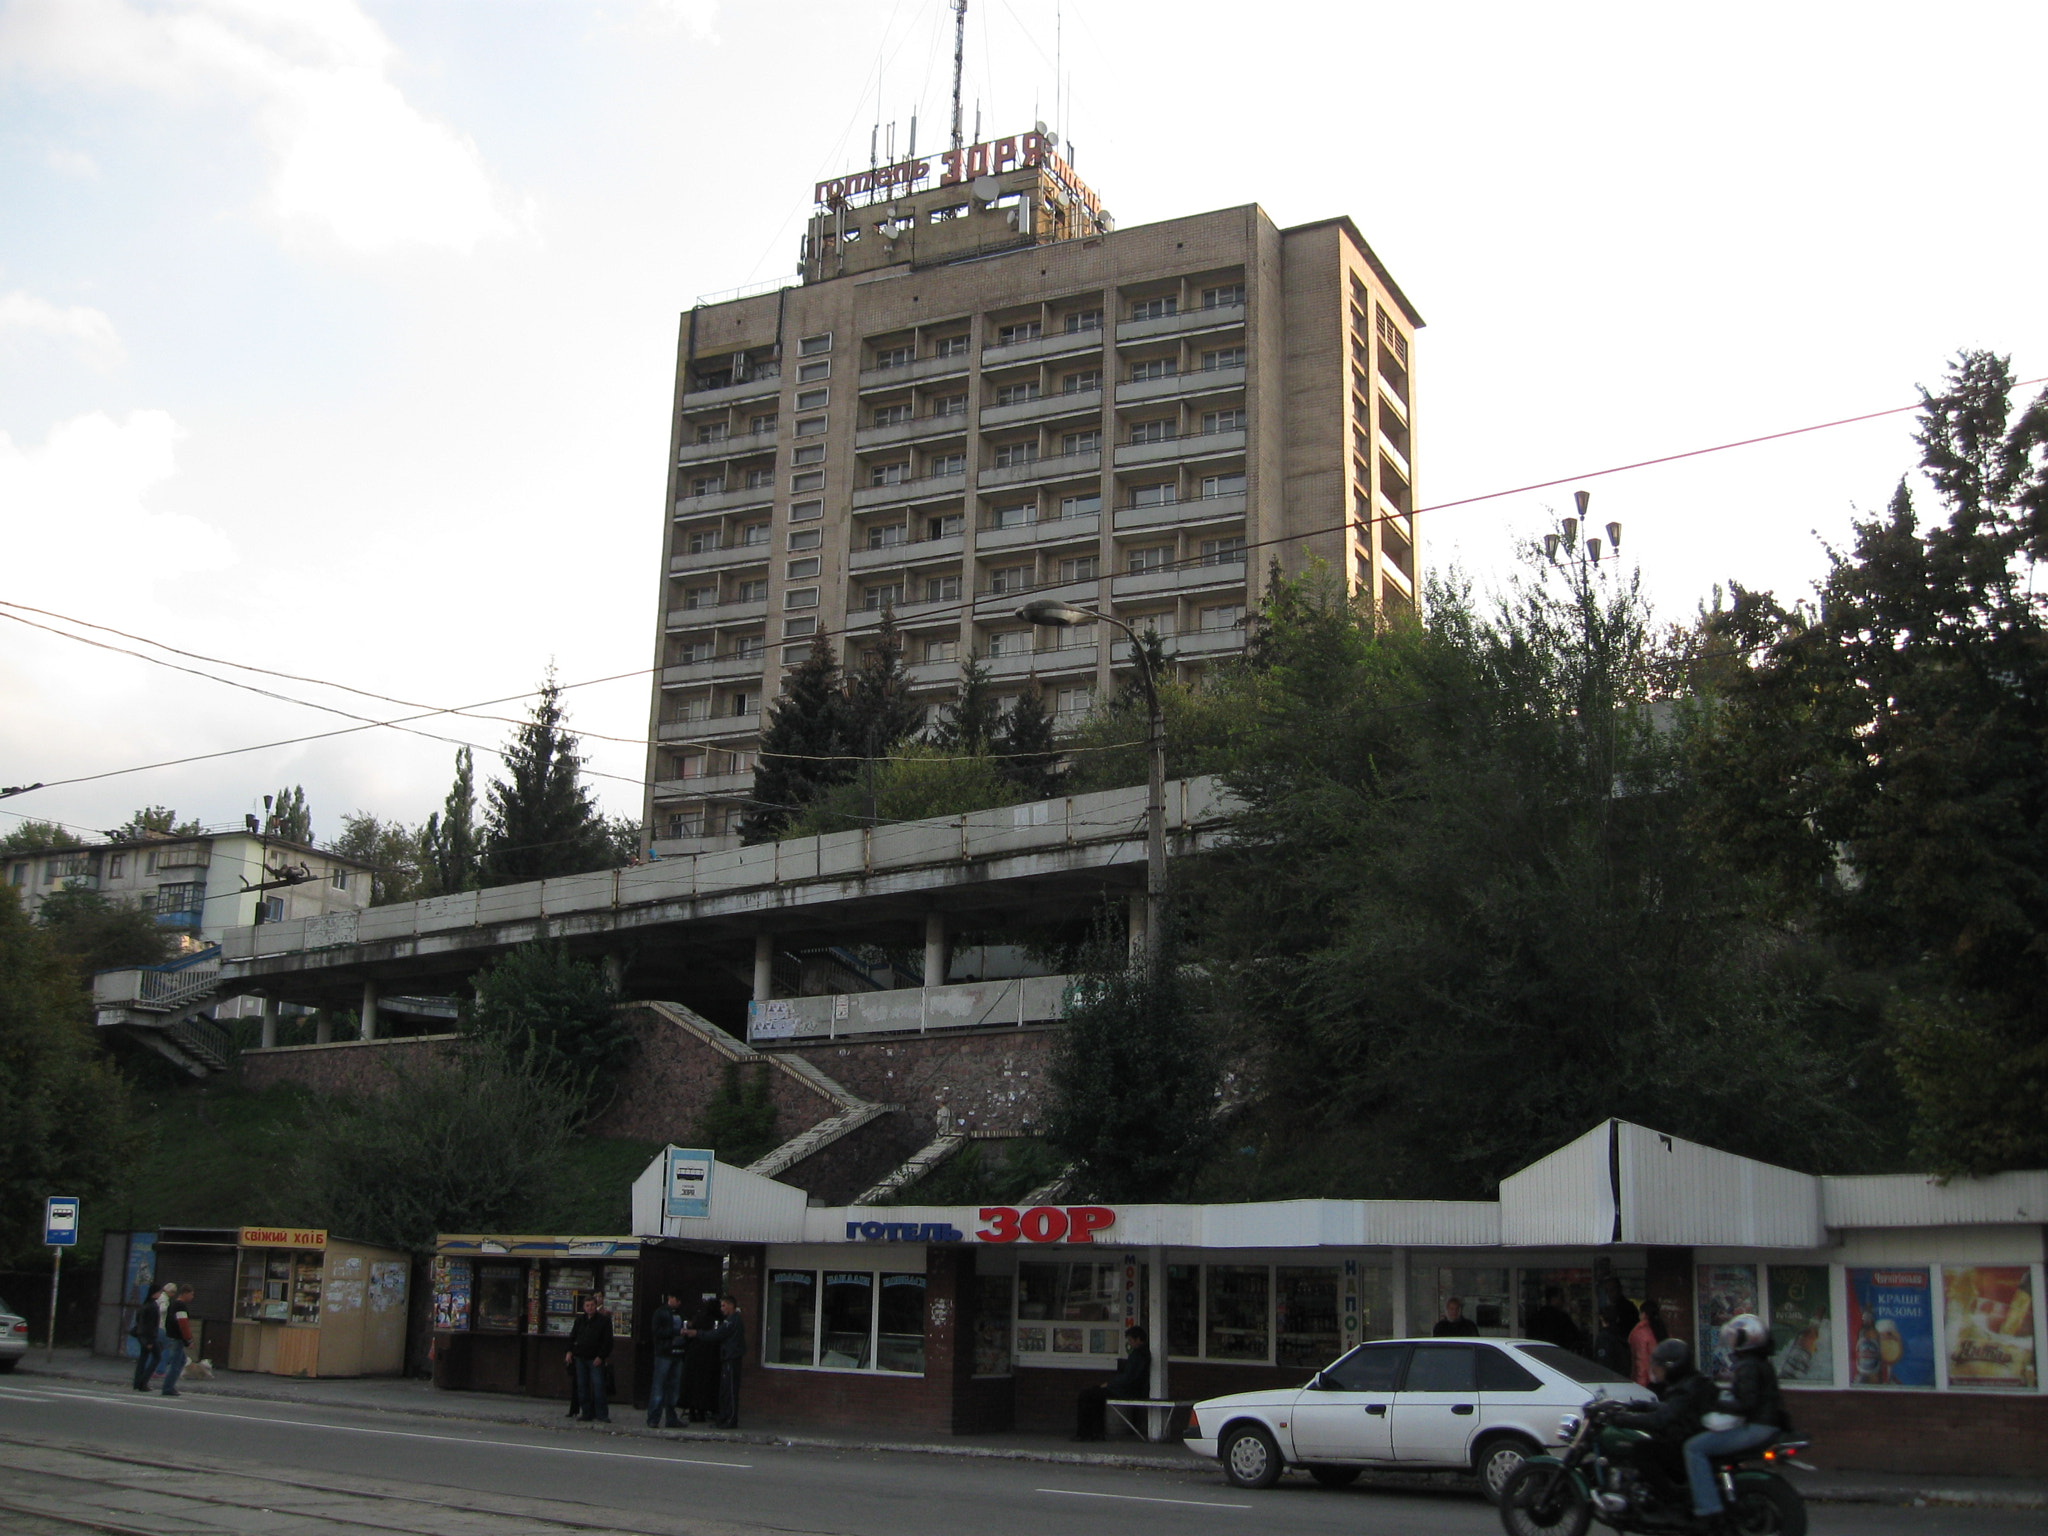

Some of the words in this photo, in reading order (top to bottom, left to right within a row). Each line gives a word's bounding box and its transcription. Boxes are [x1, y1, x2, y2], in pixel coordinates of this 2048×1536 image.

[940, 131, 1043, 187] ЗОРЯ
[294, 1230, 324, 1244] ХЛІБ
[975, 1206, 1116, 1243] ЗОР
